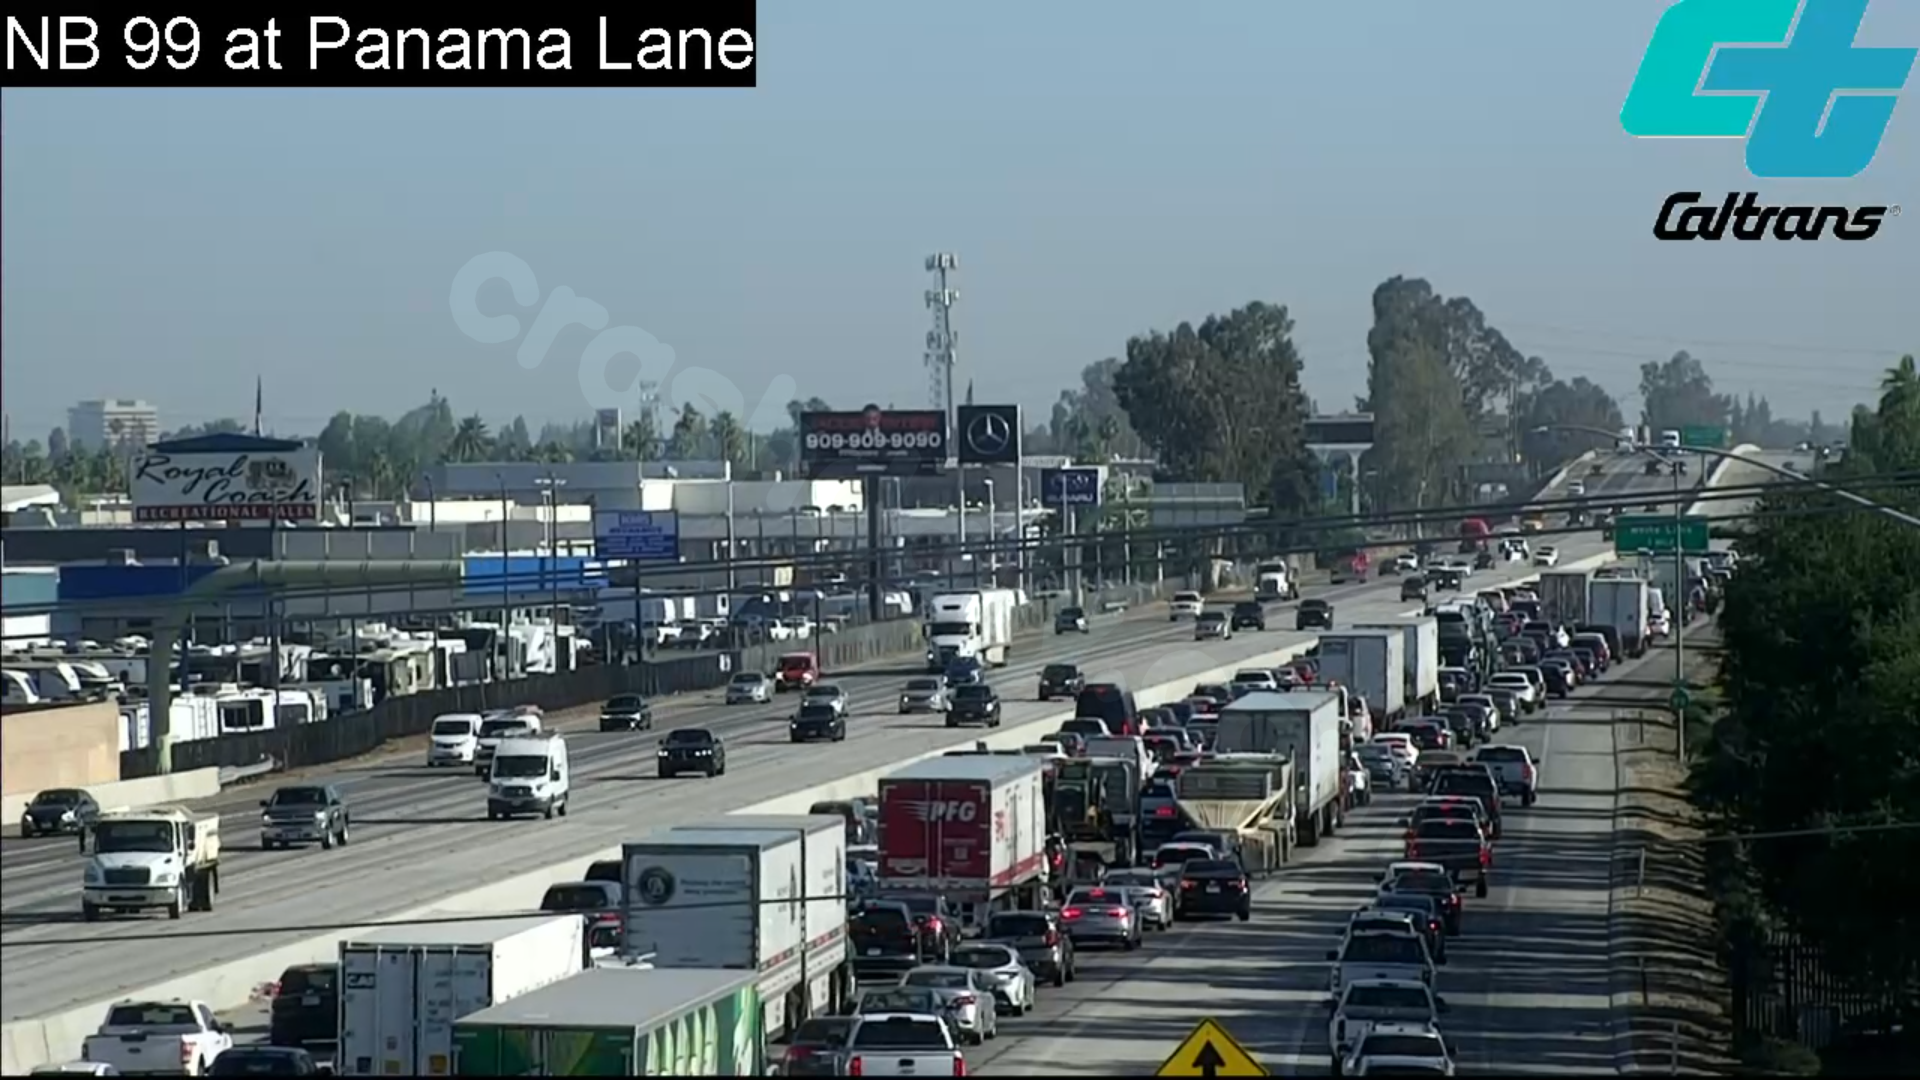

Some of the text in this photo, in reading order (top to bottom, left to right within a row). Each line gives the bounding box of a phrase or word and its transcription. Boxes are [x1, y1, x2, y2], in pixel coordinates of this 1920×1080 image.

[806, 432, 941, 449] 909-909-9090
[135, 454, 249, 496] Royal
[203, 478, 316, 504] Coach
[139, 507, 257, 519] RECREATIONAL
[929, 801, 977, 822] PFG
